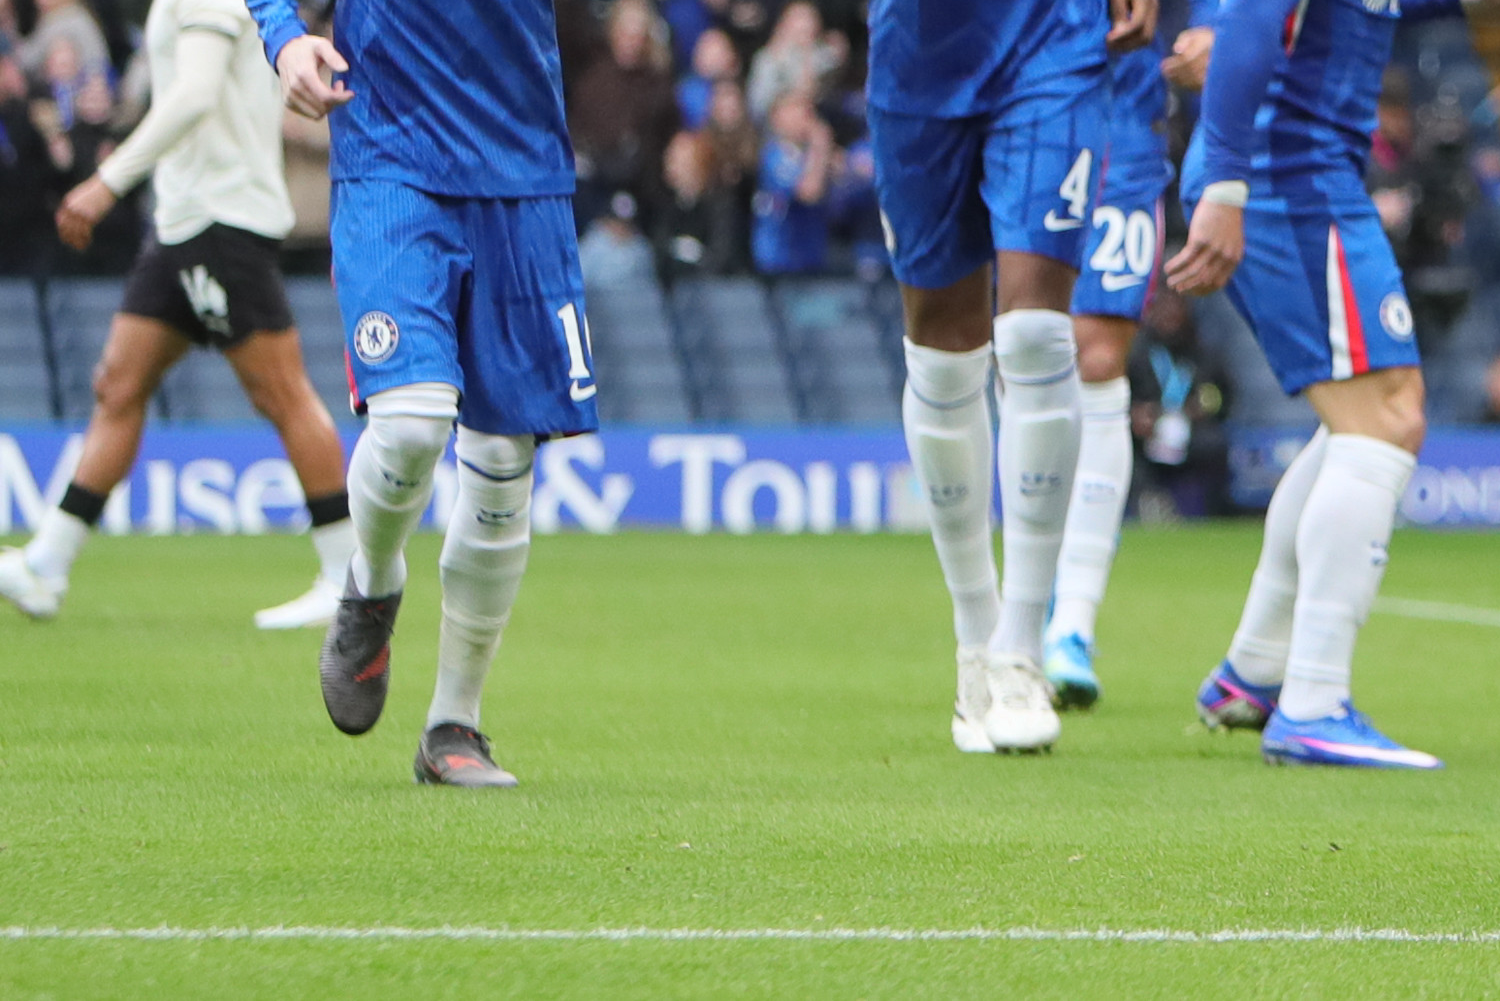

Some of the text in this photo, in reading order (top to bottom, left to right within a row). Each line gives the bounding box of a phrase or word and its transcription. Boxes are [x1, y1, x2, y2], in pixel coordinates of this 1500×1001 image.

[1059, 147, 1093, 219] 4
[1089, 205, 1157, 277] 20
[557, 302, 592, 379] 1
[0, 432, 457, 536] Muse
[533, 434, 634, 536] &
